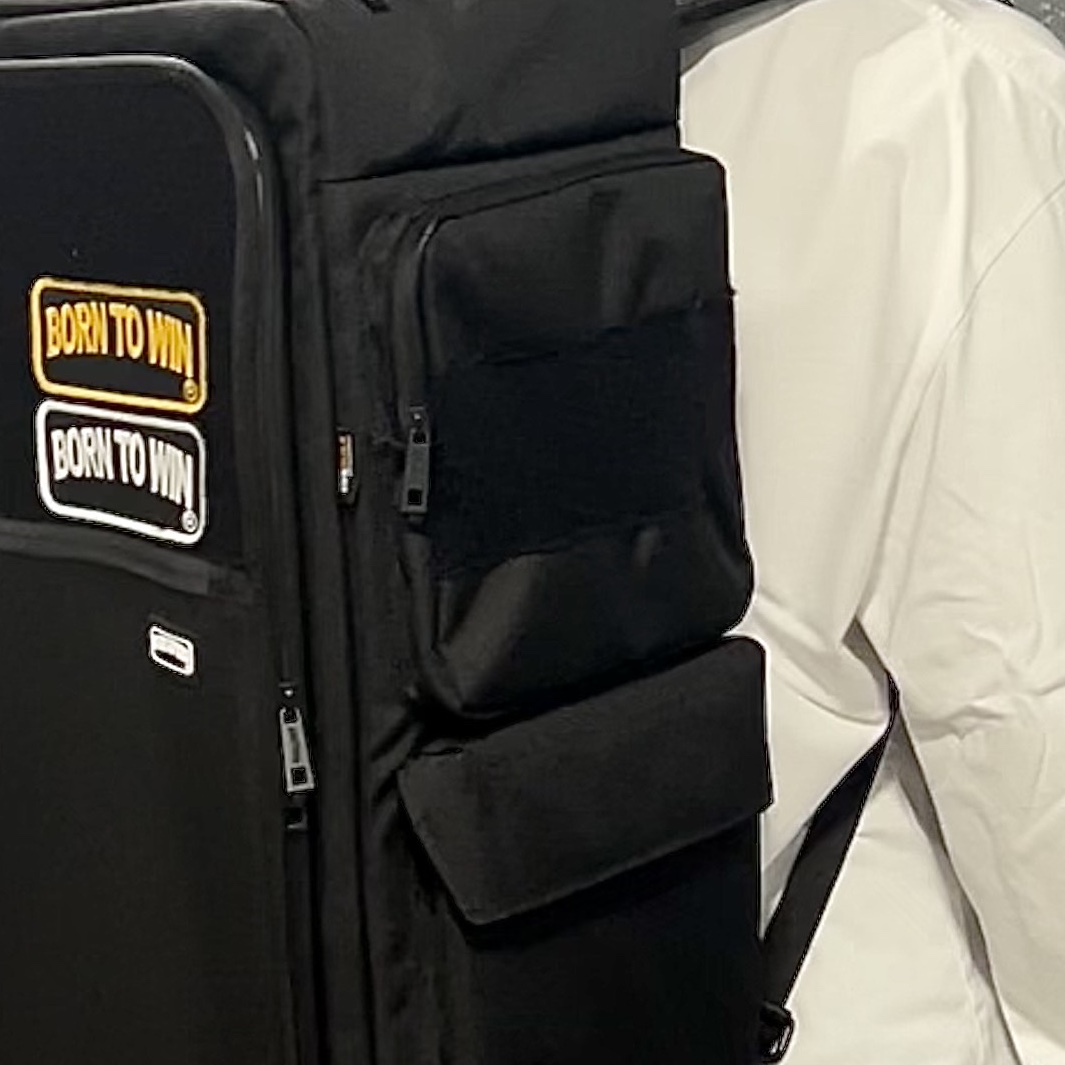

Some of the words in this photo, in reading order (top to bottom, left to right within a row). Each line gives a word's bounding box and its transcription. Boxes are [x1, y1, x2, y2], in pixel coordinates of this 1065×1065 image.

[45, 301, 108, 359] BORN
[109, 302, 145, 360] TO
[146, 308, 193, 379] WIN
[51, 427, 115, 481] BORN
[113, 428, 146, 487] TO
[149, 437, 193, 512] WIN
